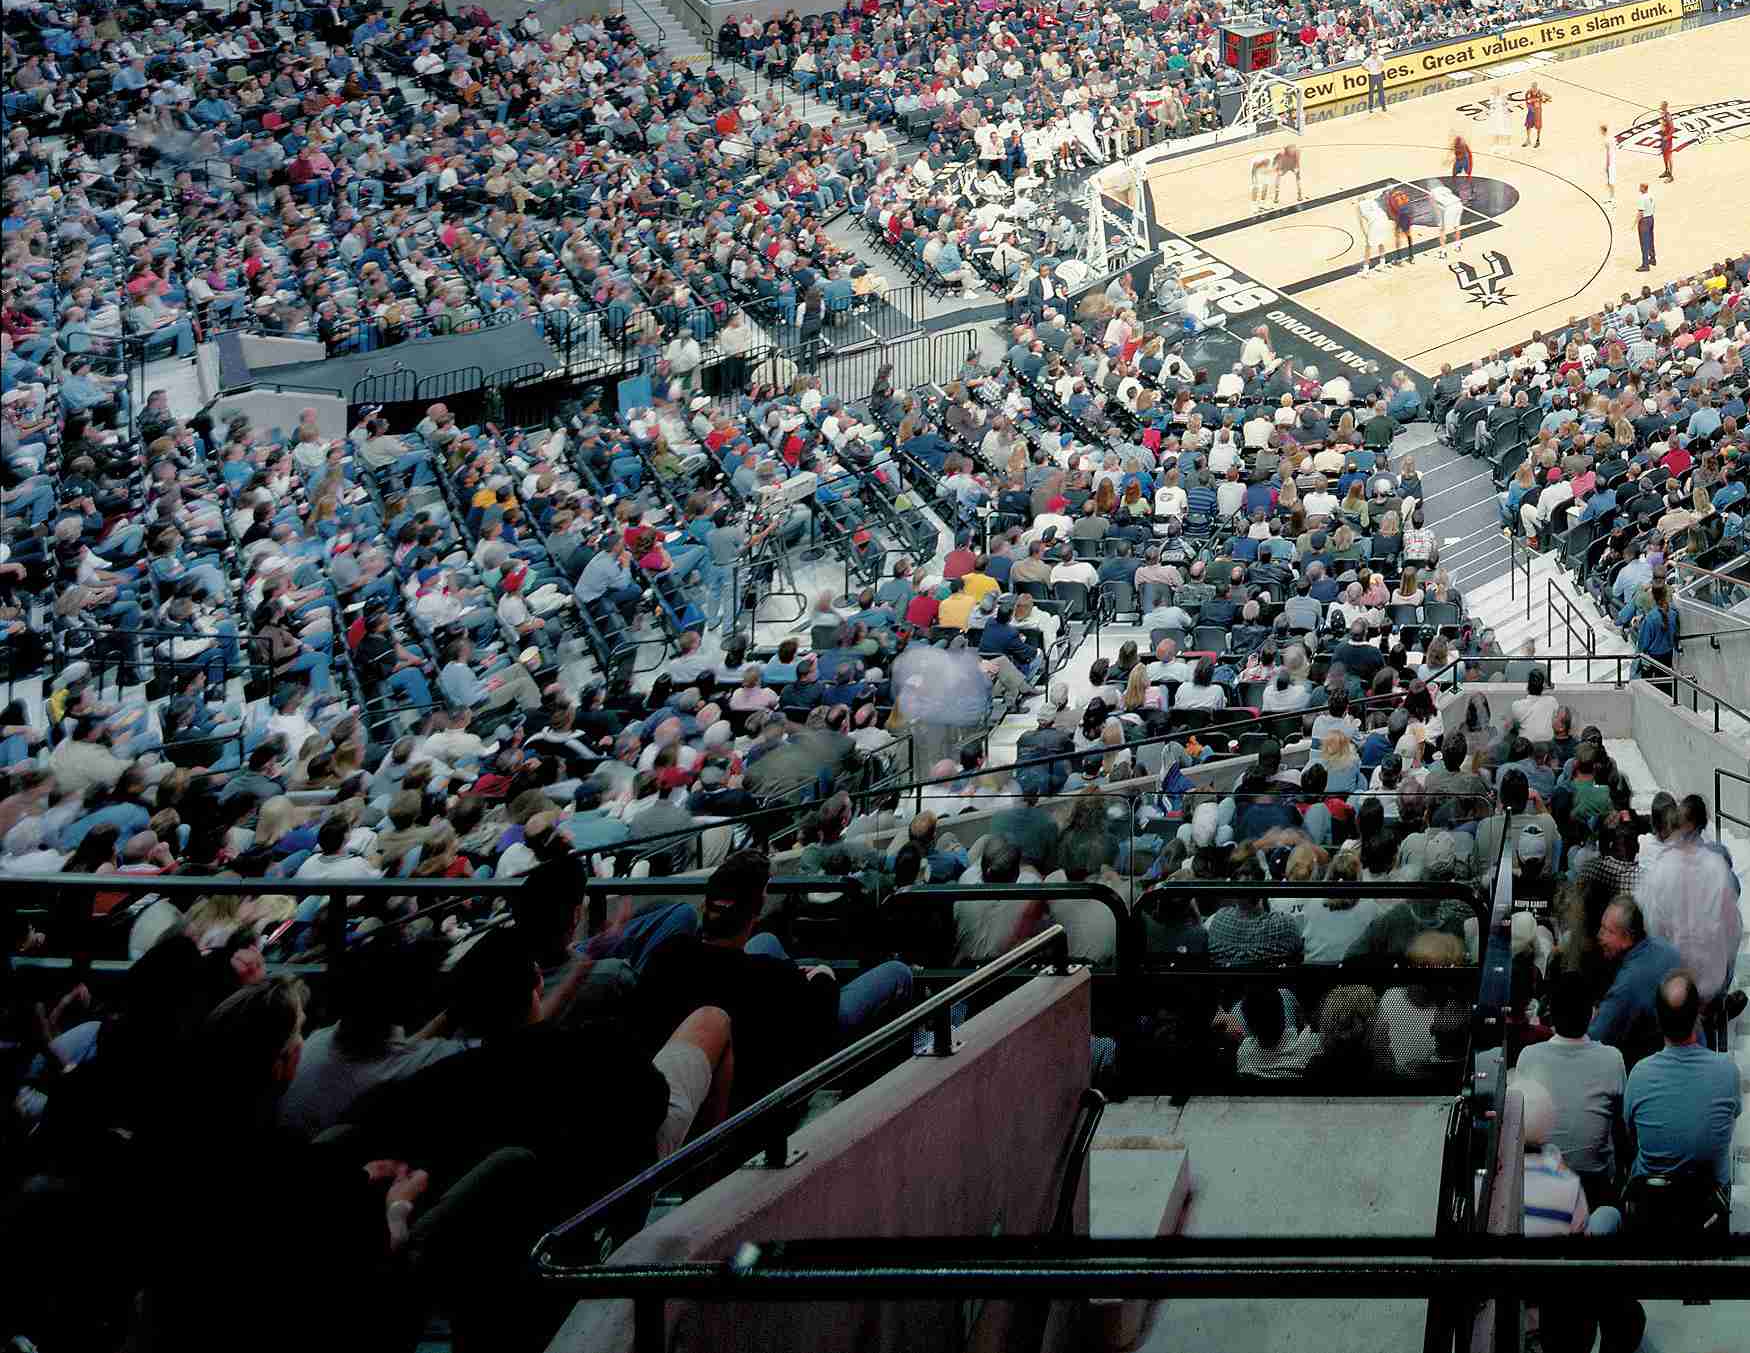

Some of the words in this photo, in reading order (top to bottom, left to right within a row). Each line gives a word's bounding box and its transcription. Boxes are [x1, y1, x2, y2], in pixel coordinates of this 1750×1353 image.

[1304, 82, 1334, 100] ew
[1422, 46, 1476, 72] Great
[1482, 35, 1535, 57] value.
[1541, 27, 1566, 43] It's
[1570, 25, 1581, 36] a
[1586, 13, 1626, 33] slam
[1631, 2, 1674, 22] dunk.
[1456, 91, 1527, 117] SC
[1266, 310, 1338, 353] ANTONIO
